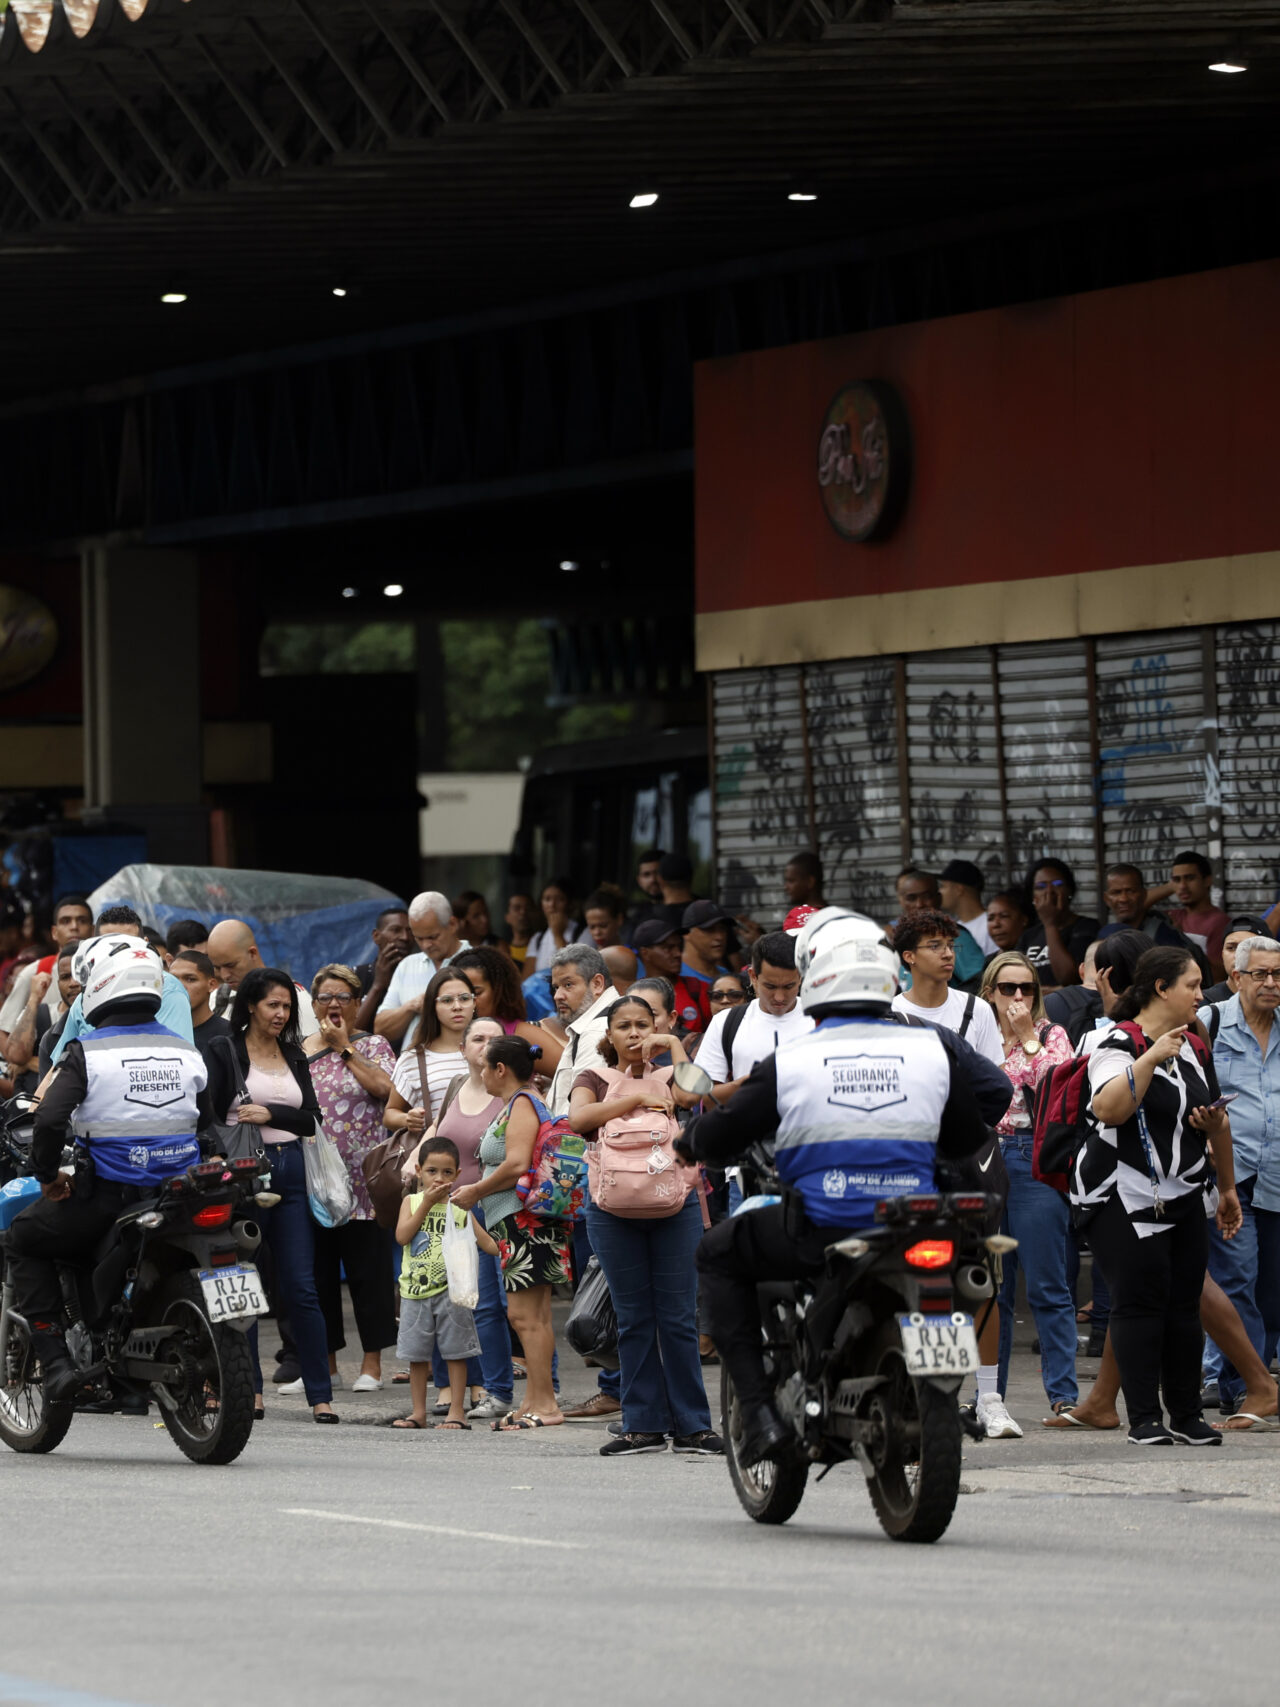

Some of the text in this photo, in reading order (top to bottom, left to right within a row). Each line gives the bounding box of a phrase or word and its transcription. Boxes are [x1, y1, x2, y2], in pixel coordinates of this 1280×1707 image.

[129, 1069, 181, 1083] SEGURANÇA
[832, 1067, 900, 1083] SEGURANÇA
[130, 1082, 182, 1093] PRESENTE
[833, 1083, 901, 1094] PRESENTE
[848, 1176, 920, 1187] RIO DE JANEIRO
[214, 1275, 250, 1296] RIZ
[919, 1327, 958, 1346] RIY
